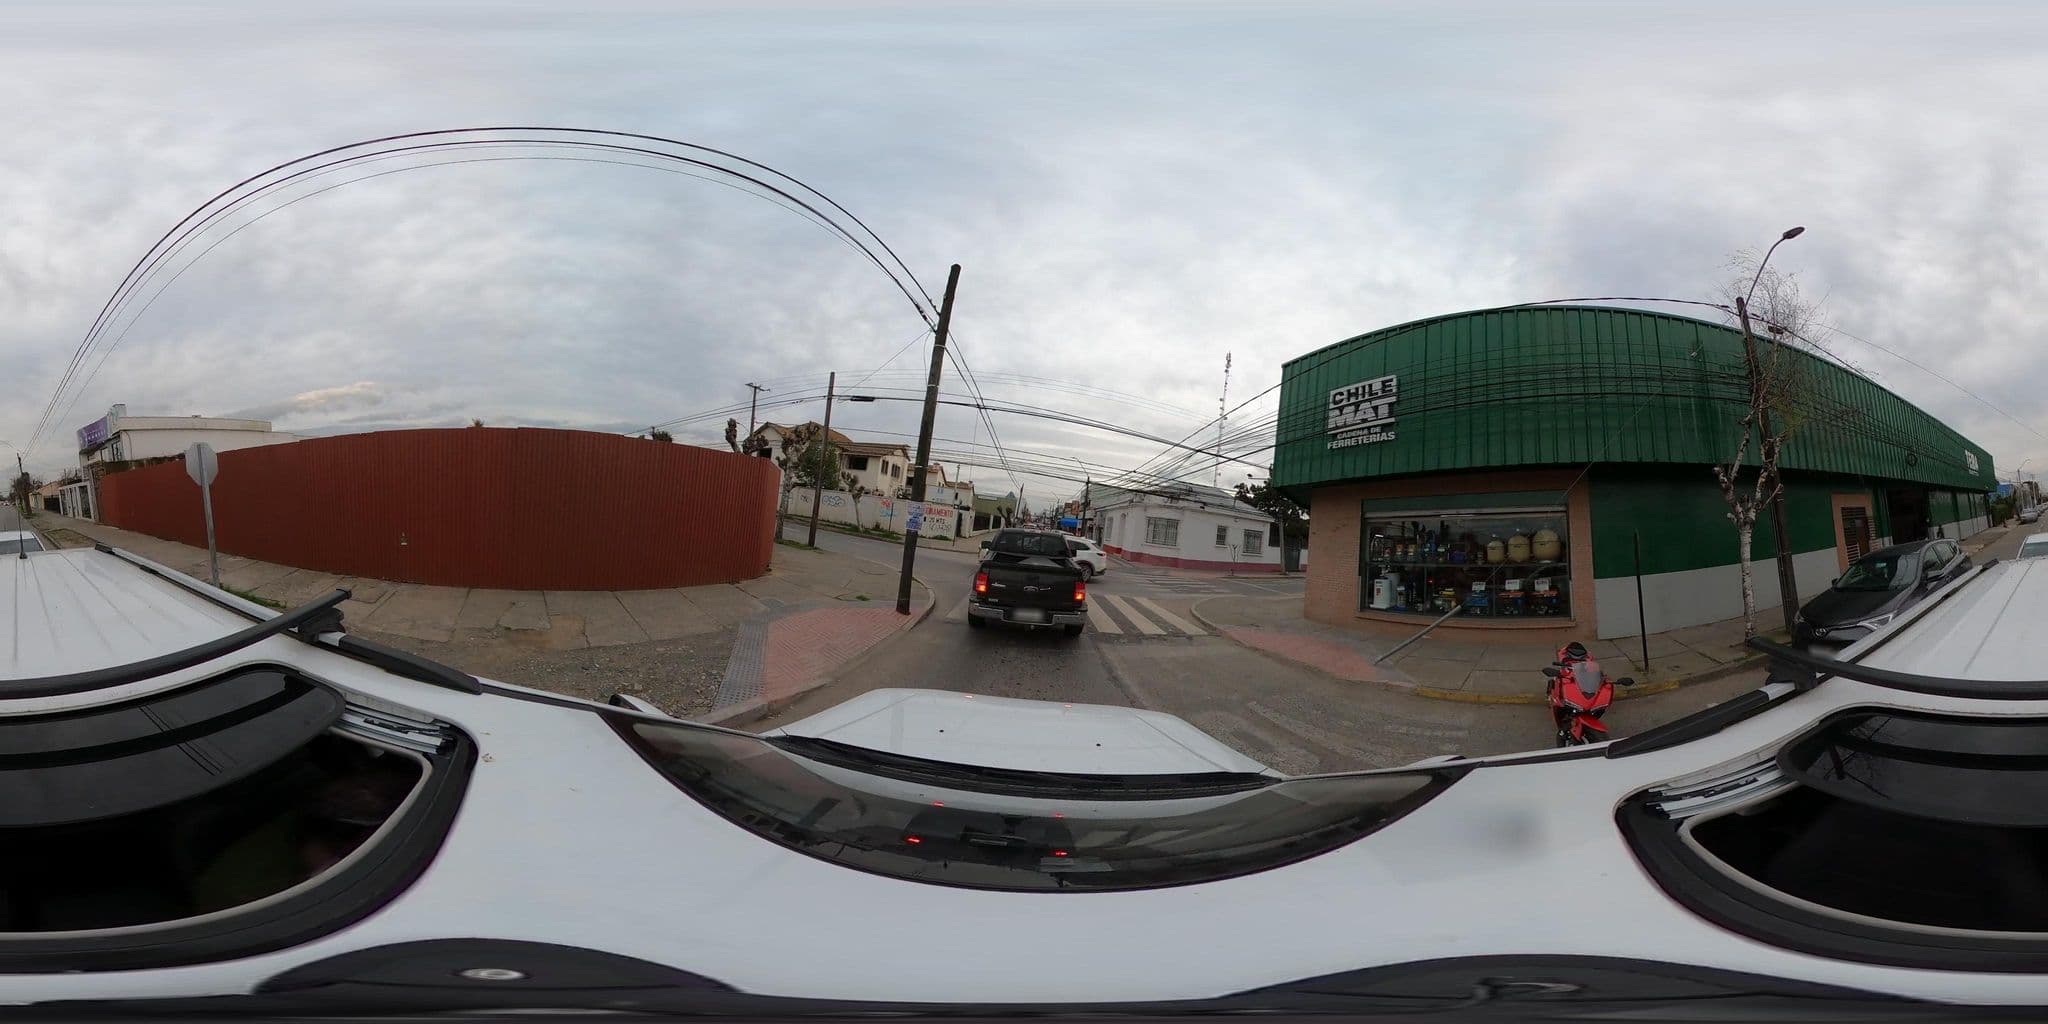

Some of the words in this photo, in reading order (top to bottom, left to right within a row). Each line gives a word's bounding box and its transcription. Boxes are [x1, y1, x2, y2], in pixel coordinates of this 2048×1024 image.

[1332, 378, 1394, 405] CHILE
[1328, 396, 1396, 428] MAT
[1327, 431, 1396, 450] FERRETERIAS
[1337, 428, 1369, 439] CADENA
[1370, 426, 1382, 434] DE
